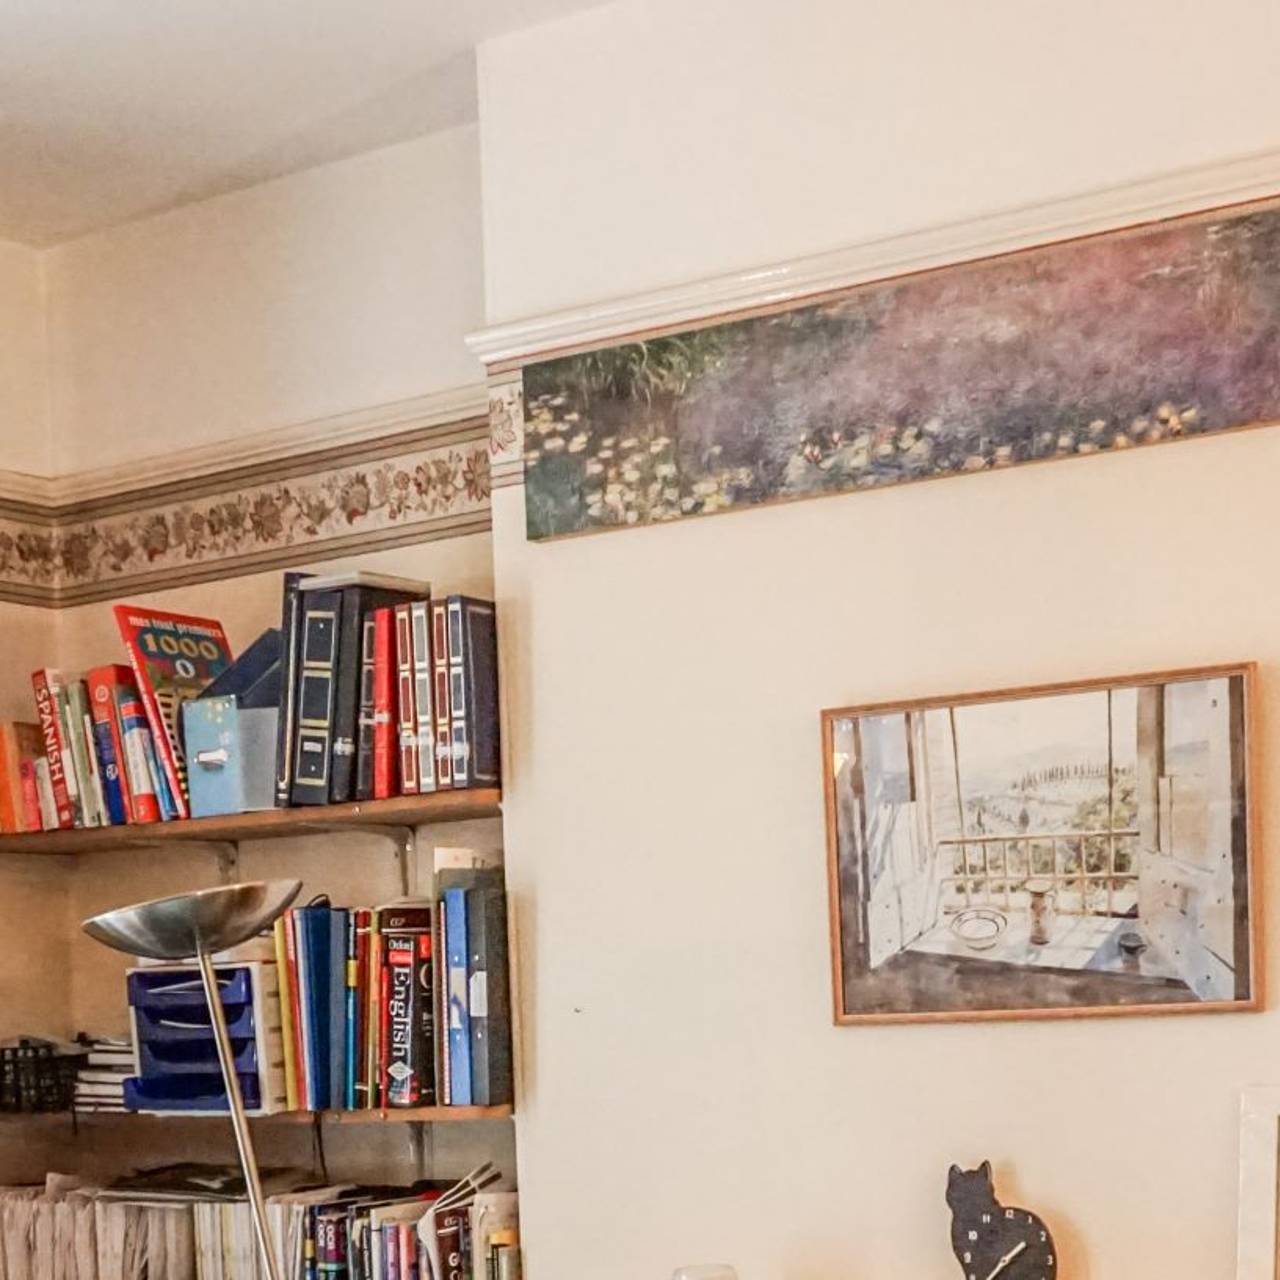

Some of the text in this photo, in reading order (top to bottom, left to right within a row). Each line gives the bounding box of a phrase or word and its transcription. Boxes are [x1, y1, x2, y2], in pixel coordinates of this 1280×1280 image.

[143, 633, 218, 660] 1000
[35, 688, 64, 780] SPANISH
[390, 966, 412, 1059] English
[326, 1225, 334, 1249] OCR
